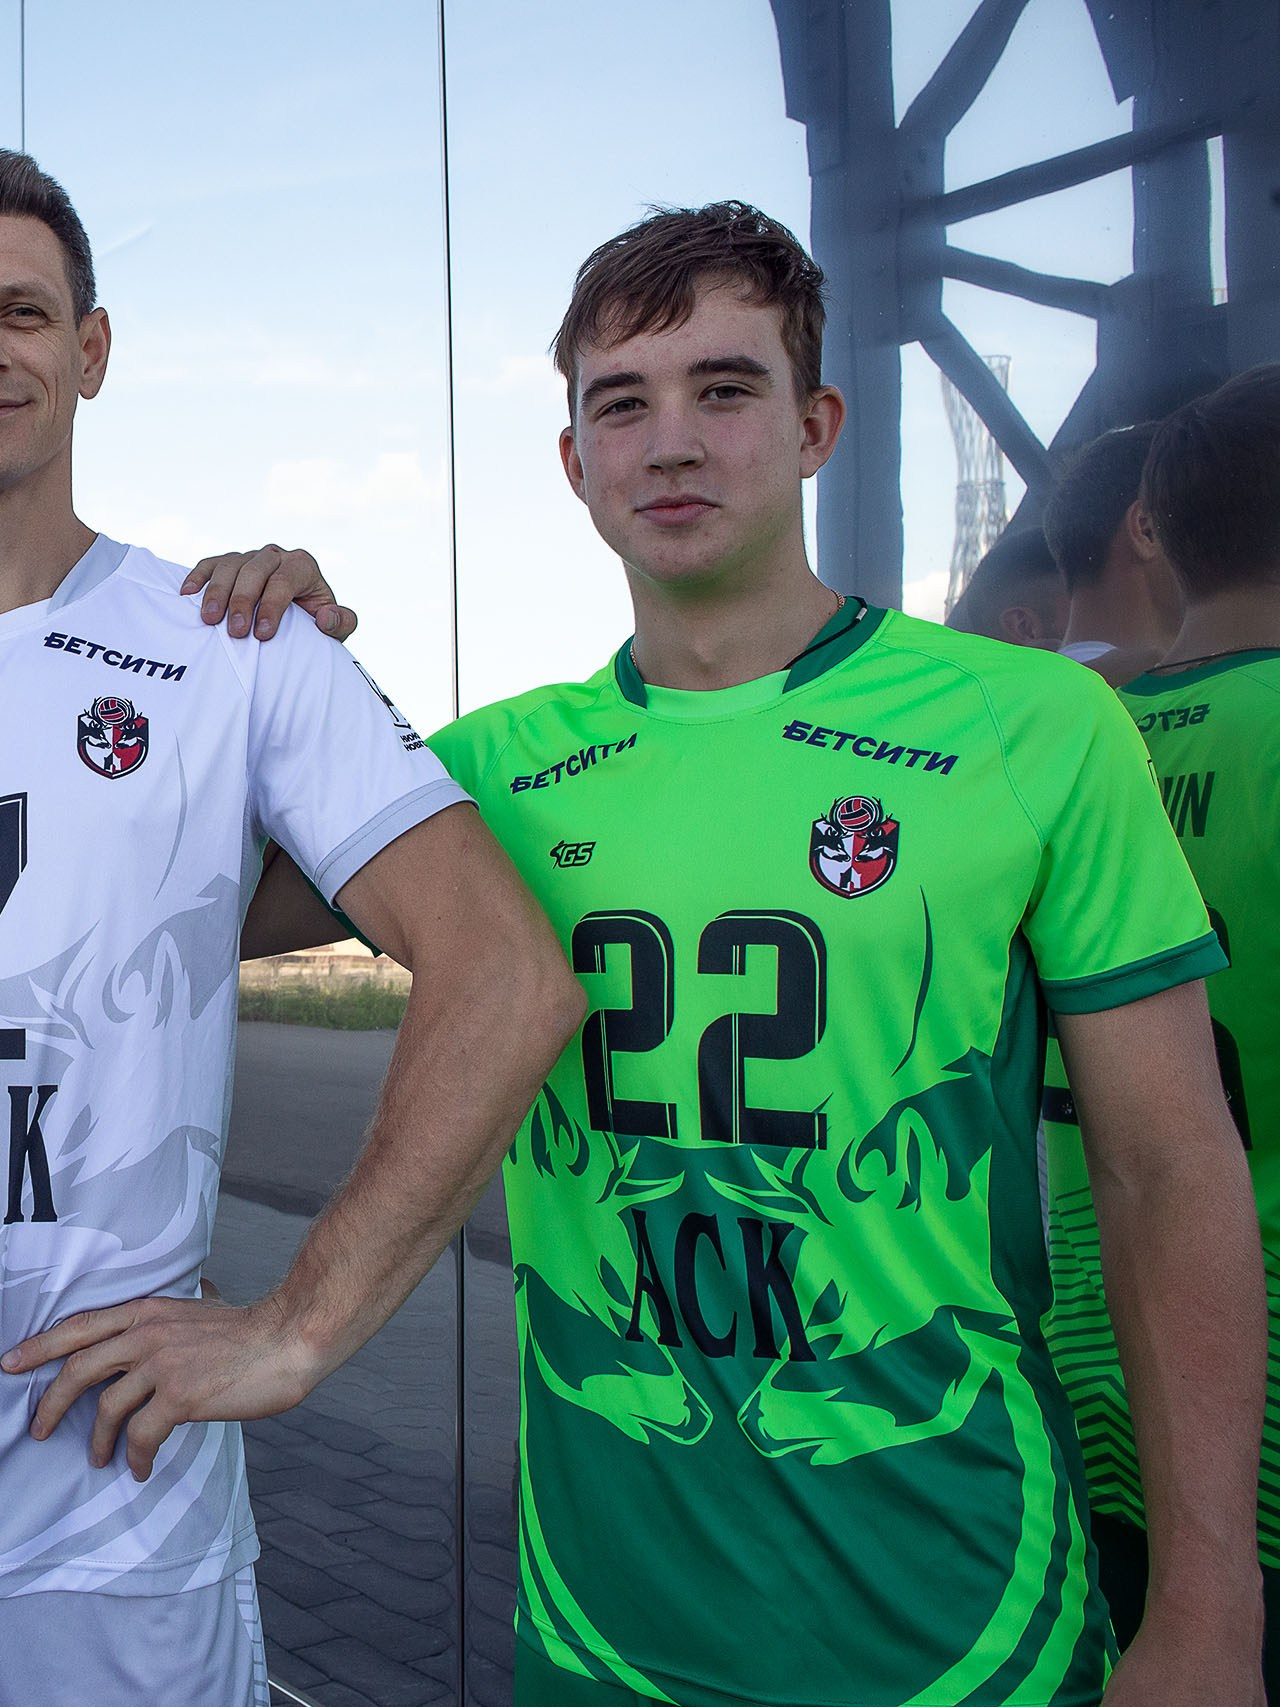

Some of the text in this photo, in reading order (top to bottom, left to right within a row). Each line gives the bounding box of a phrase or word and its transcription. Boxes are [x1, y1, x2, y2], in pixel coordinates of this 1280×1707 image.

[43, 631, 188, 682] БЕТСИТИ
[510, 732, 638, 795] БЕТСИТИ
[782, 719, 959, 776] БЕТСИТИ
[571, 908, 828, 1150] 22
[624, 1207, 817, 1363] АСК
